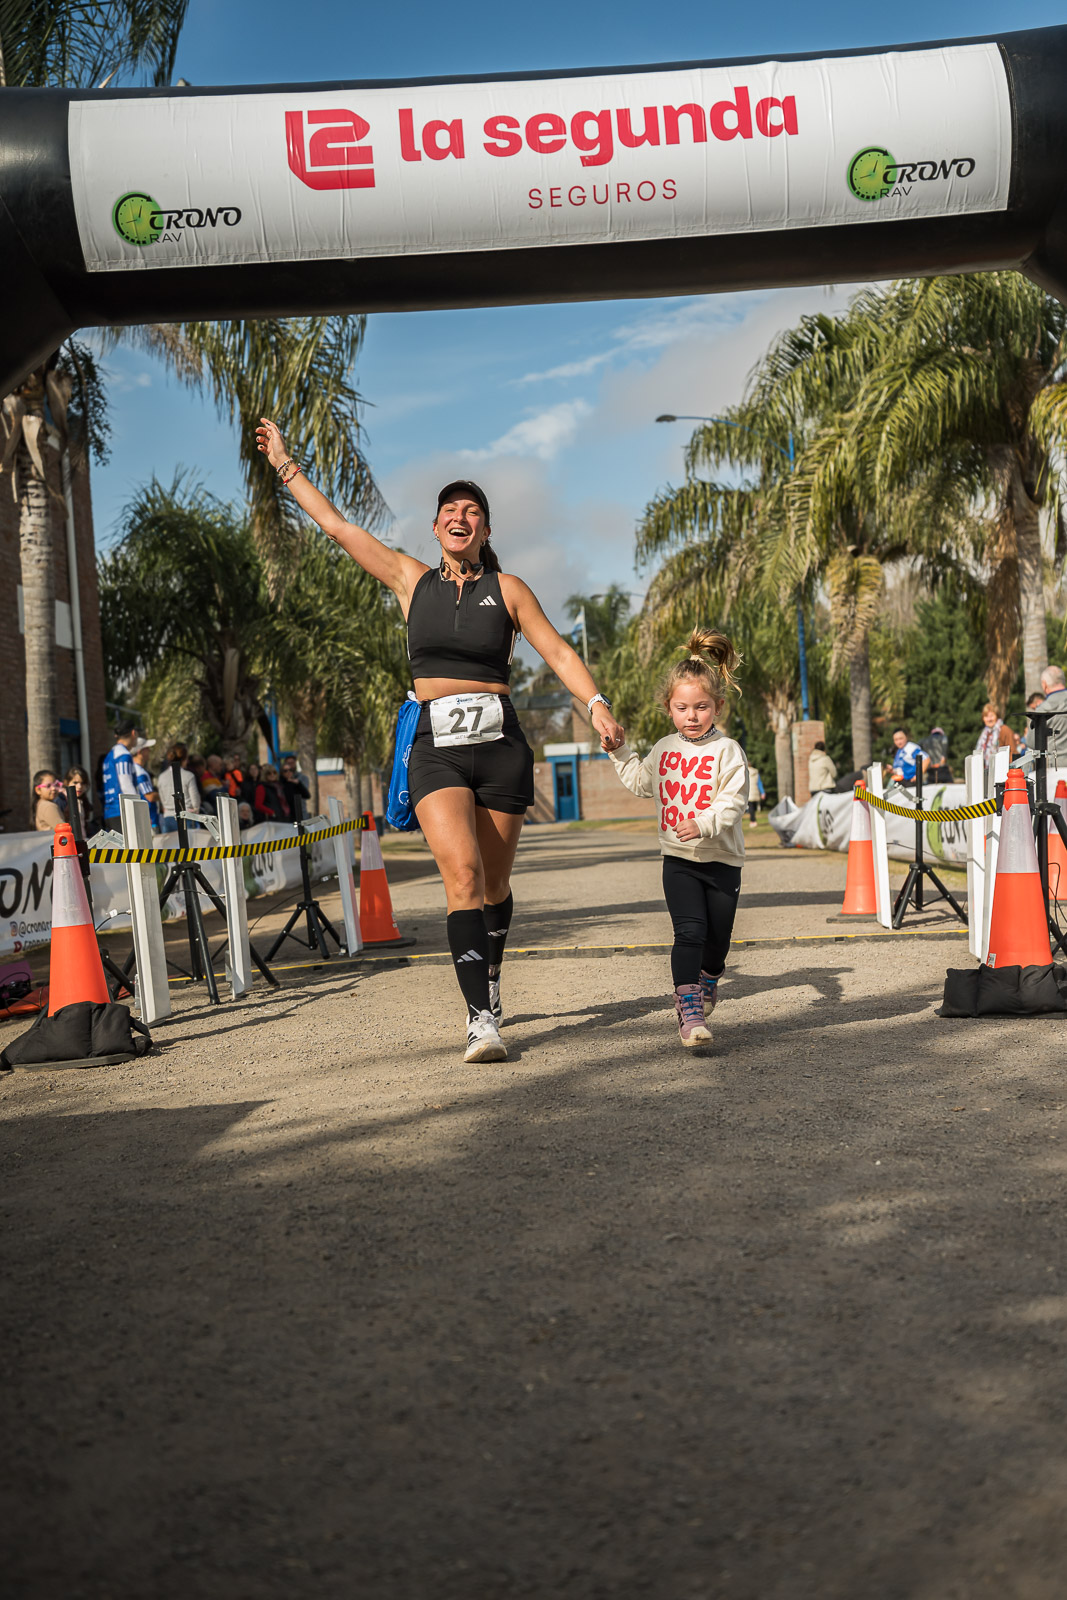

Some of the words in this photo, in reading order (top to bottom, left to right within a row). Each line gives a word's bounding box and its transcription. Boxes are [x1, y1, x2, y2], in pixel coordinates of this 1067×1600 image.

[398, 108, 465, 162] la
[483, 86, 799, 168] segunda
[882, 157, 976, 185] CRONO
[527, 178, 678, 209] SEGUROS
[880, 186, 913, 199] RAV
[149, 206, 242, 230] CRONO
[149, 232, 182, 244] RAV
[448, 706, 484, 734] 27
[658, 751, 715, 780] LOVE
